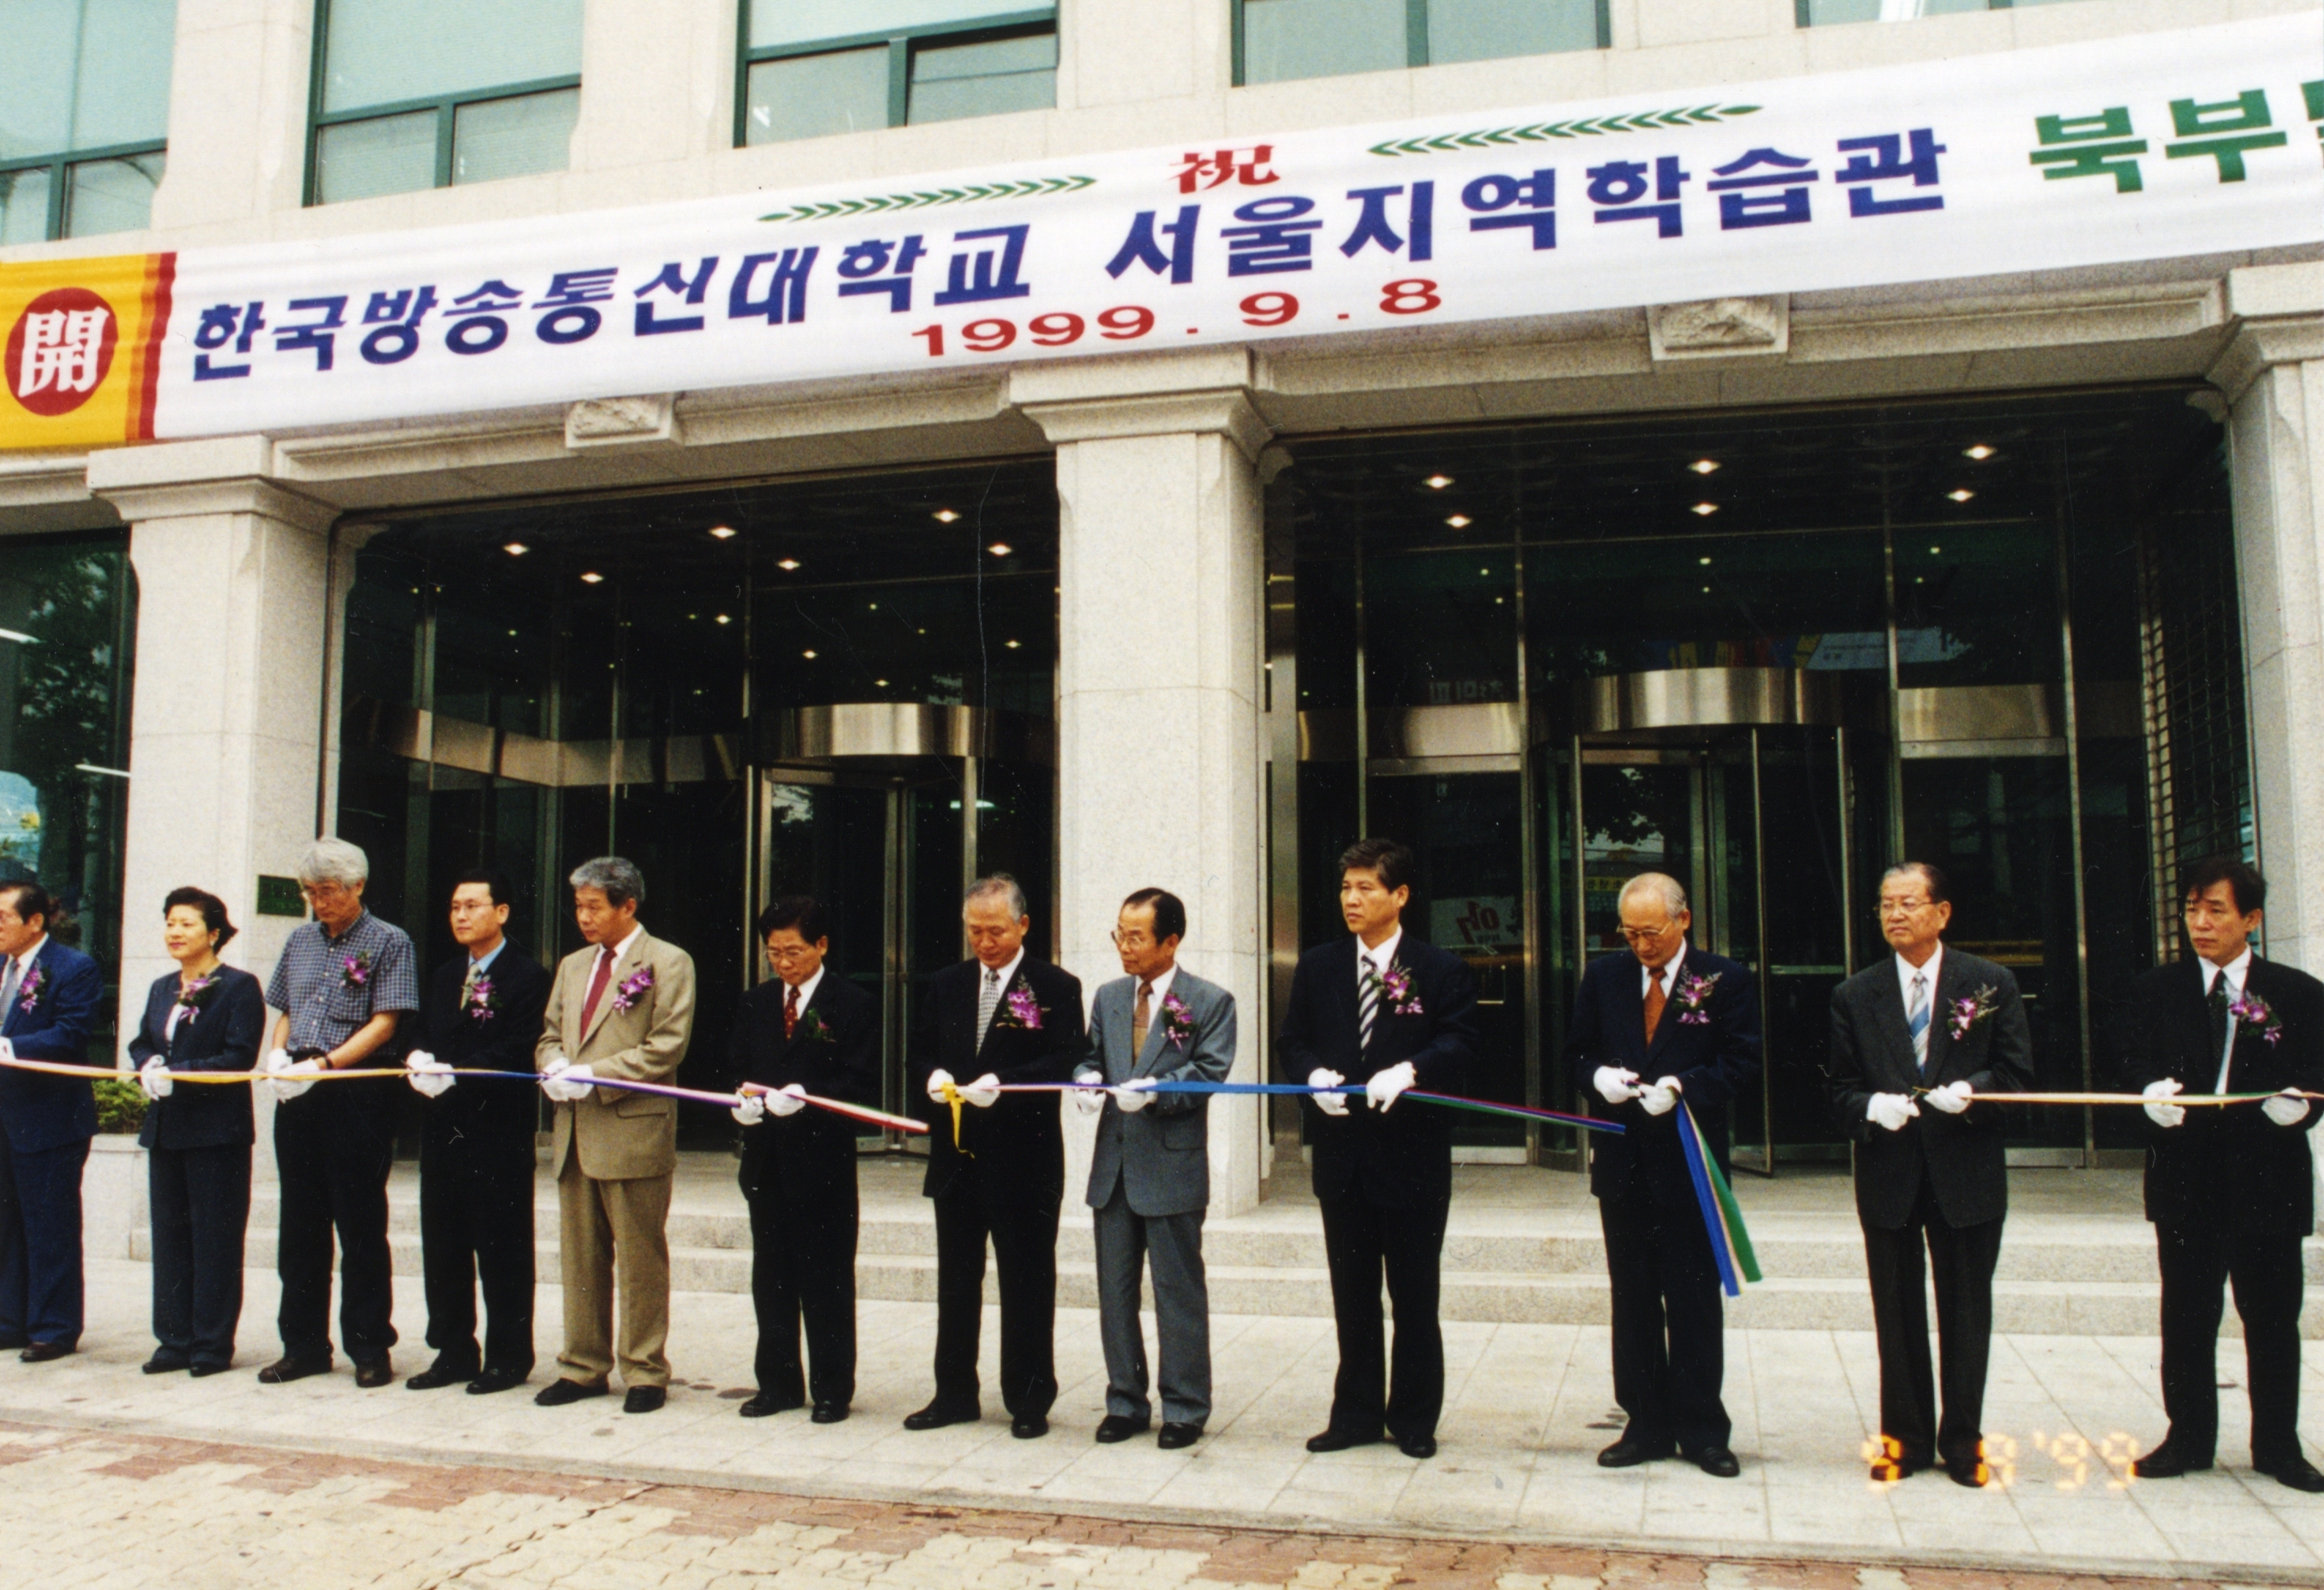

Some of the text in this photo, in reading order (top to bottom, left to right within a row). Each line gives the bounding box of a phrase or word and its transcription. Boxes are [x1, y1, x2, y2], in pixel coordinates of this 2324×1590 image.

[1169, 143, 1281, 195] 祝
[192, 79, 2324, 382] 한국방송통신대학교 서울지역학습관 북부
[17, 305, 110, 399] 開
